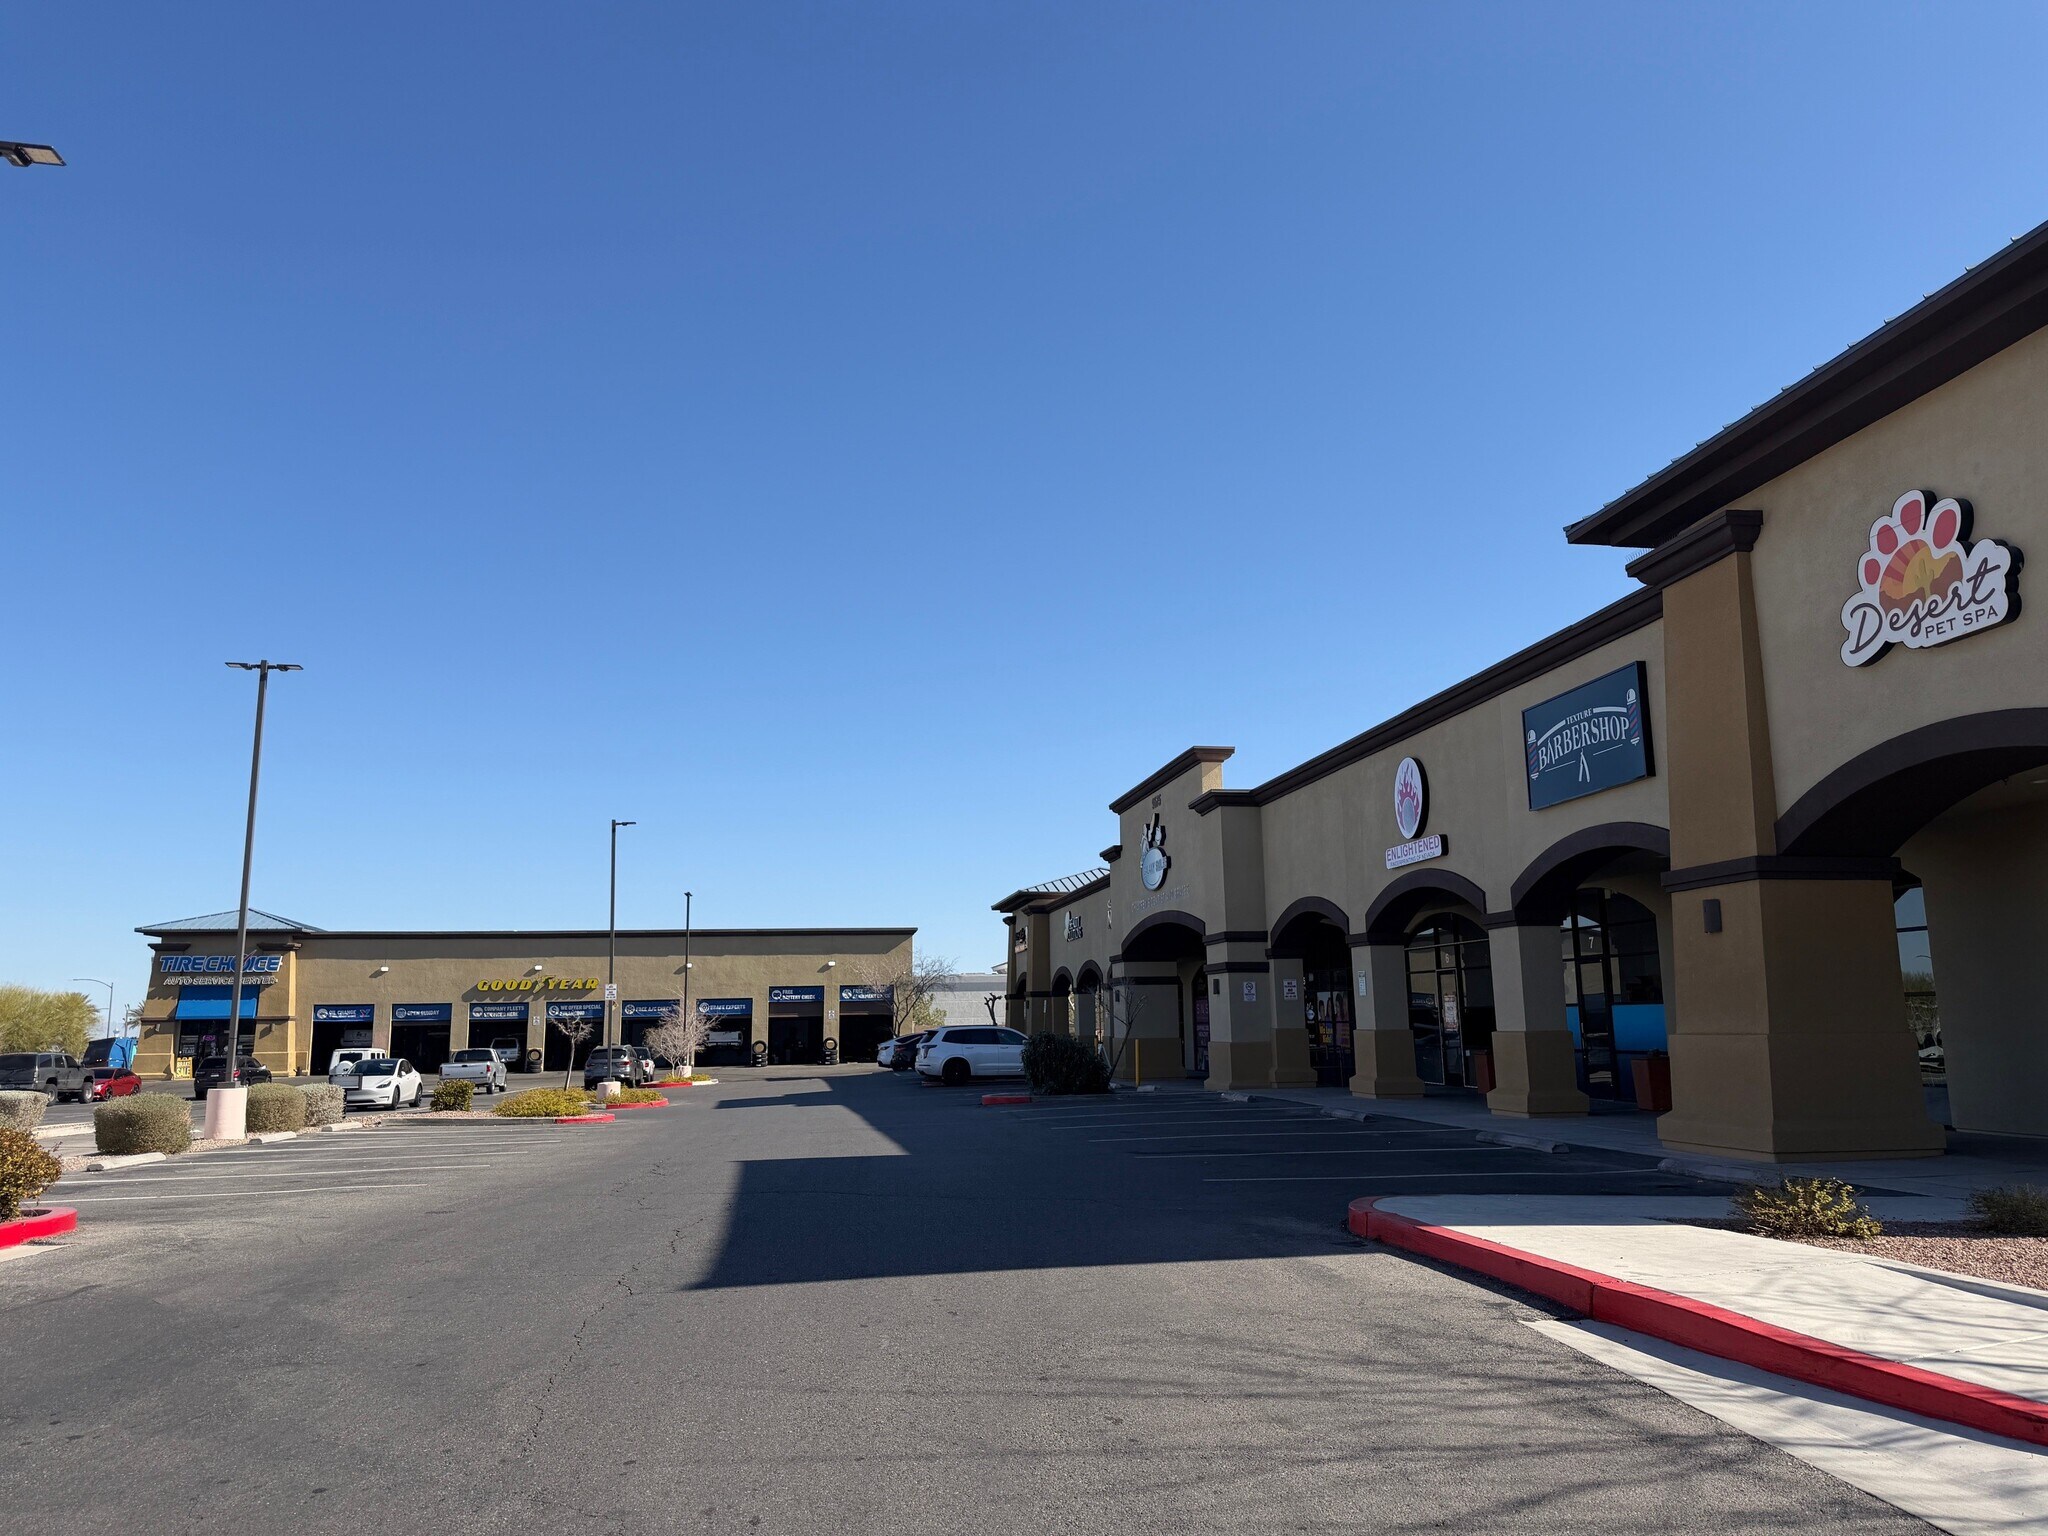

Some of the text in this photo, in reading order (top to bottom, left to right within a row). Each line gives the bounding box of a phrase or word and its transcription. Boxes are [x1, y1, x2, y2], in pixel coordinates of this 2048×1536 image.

[1849, 556, 2001, 655] Desert
[1925, 605, 1999, 639] PET SPA
[1566, 707, 1593, 725] TEXTURE
[1538, 715, 1630, 771] BARBERSHOP
[1386, 835, 1440, 862] ENLIGHTENED
[1588, 936, 1595, 949] 7
[160, 955, 203, 973] TIRE
[163, 975, 278, 986] AUTO SERVICE ENTER
[176, 1067, 190, 1077] SALE
